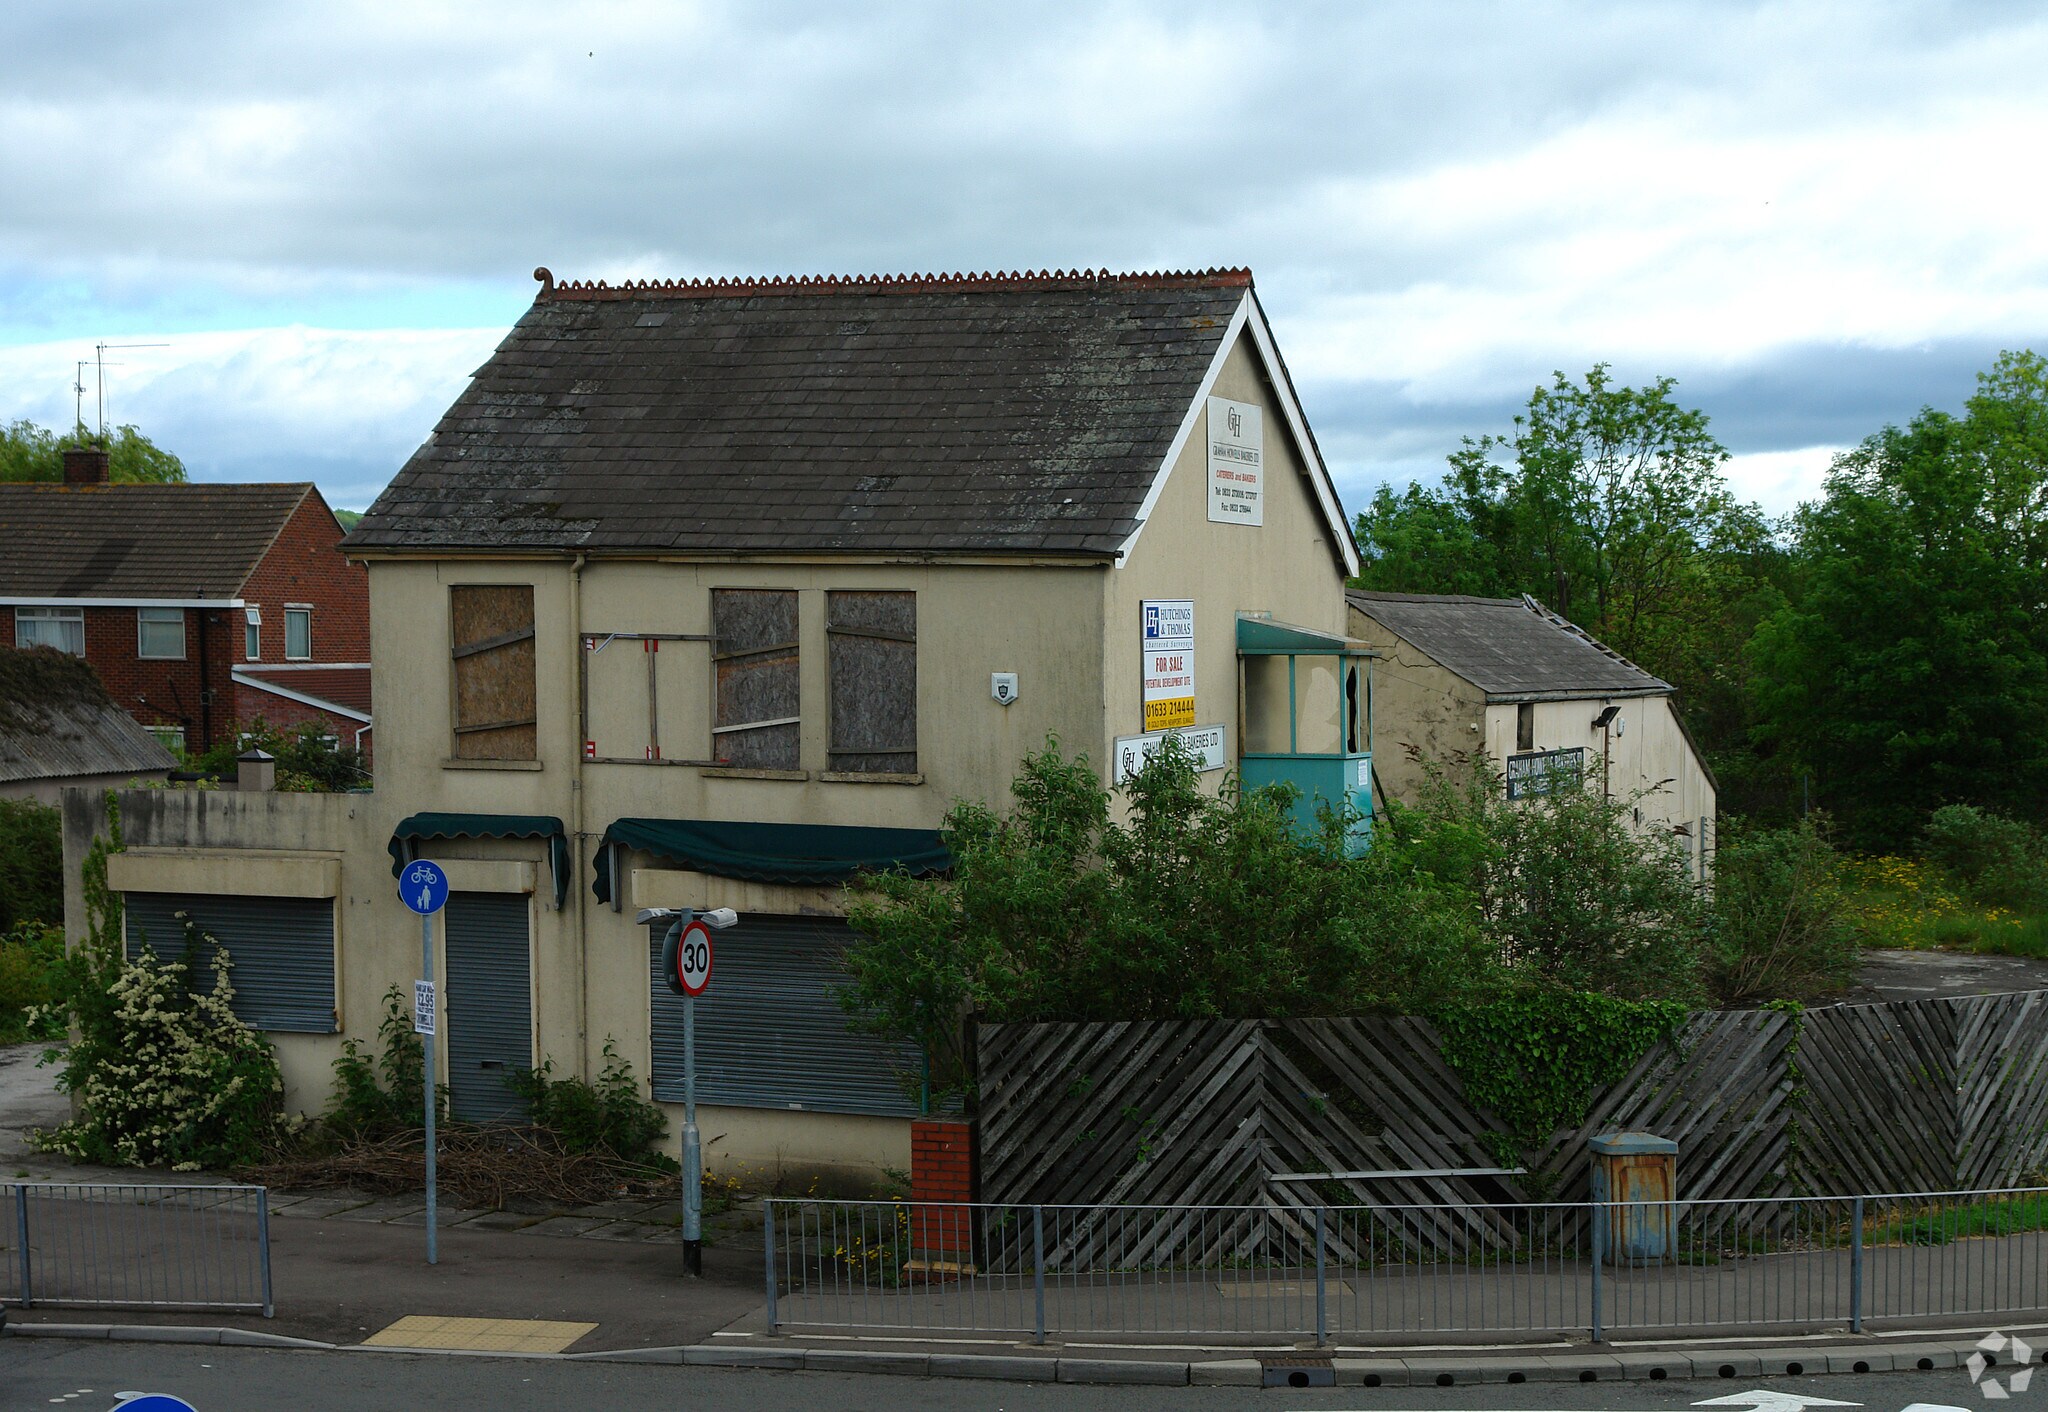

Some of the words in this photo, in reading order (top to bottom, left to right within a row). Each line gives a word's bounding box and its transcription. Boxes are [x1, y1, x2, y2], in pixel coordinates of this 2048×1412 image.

[1242, 473, 1256, 484] BAKERS
[1160, 608, 1191, 621] HUTCHINGS
[1161, 625, 1166, 635] &
[1167, 623, 1191, 635] THOMAS
[1155, 657, 1167, 673] FOR
[1169, 656, 1183, 672] SALE
[1162, 677, 1183, 688] DEVELOPMENT
[1146, 702, 1166, 718] 01633
[1170, 700, 1194, 716] 214444
[1210, 732, 1218, 746] LTD
[684, 943, 707, 973] 30
[418, 993, 433, 1007] £2.95
